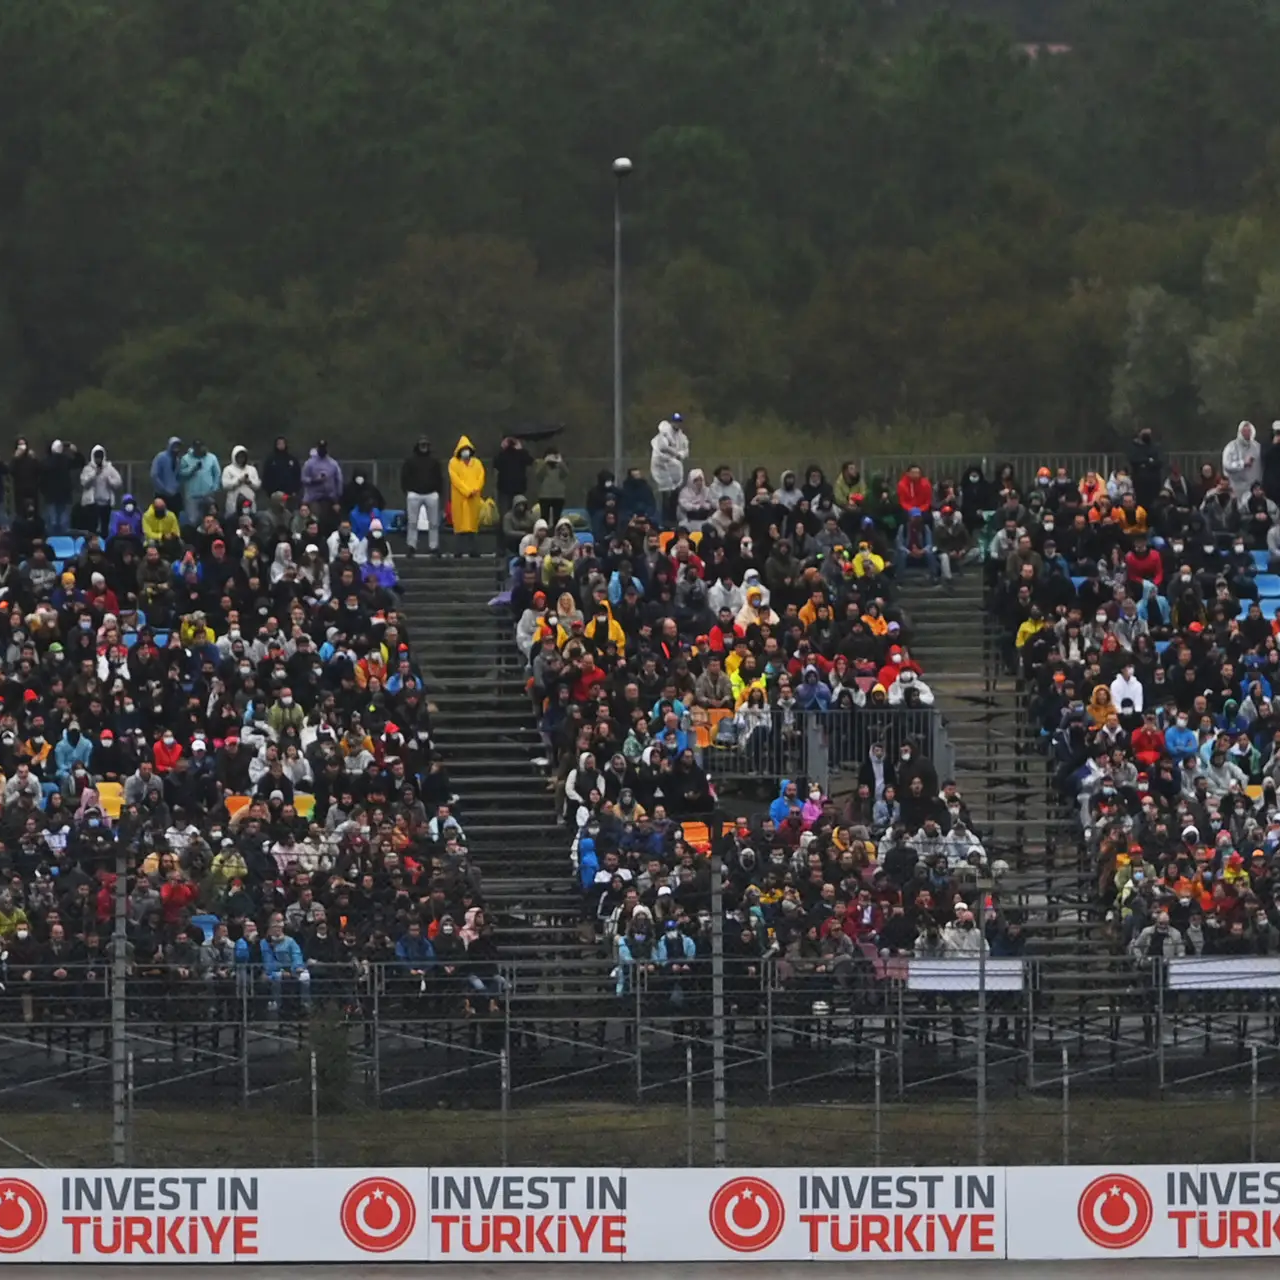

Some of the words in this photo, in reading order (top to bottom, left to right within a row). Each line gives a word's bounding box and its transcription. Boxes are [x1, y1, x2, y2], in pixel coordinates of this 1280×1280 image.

[62, 1178, 206, 1210] INVEST
[218, 1178, 258, 1210] IN
[431, 1177, 575, 1209] INVEST
[587, 1177, 626, 1210] IN
[800, 1176, 943, 1209] INVEST
[955, 1176, 994, 1208] IN
